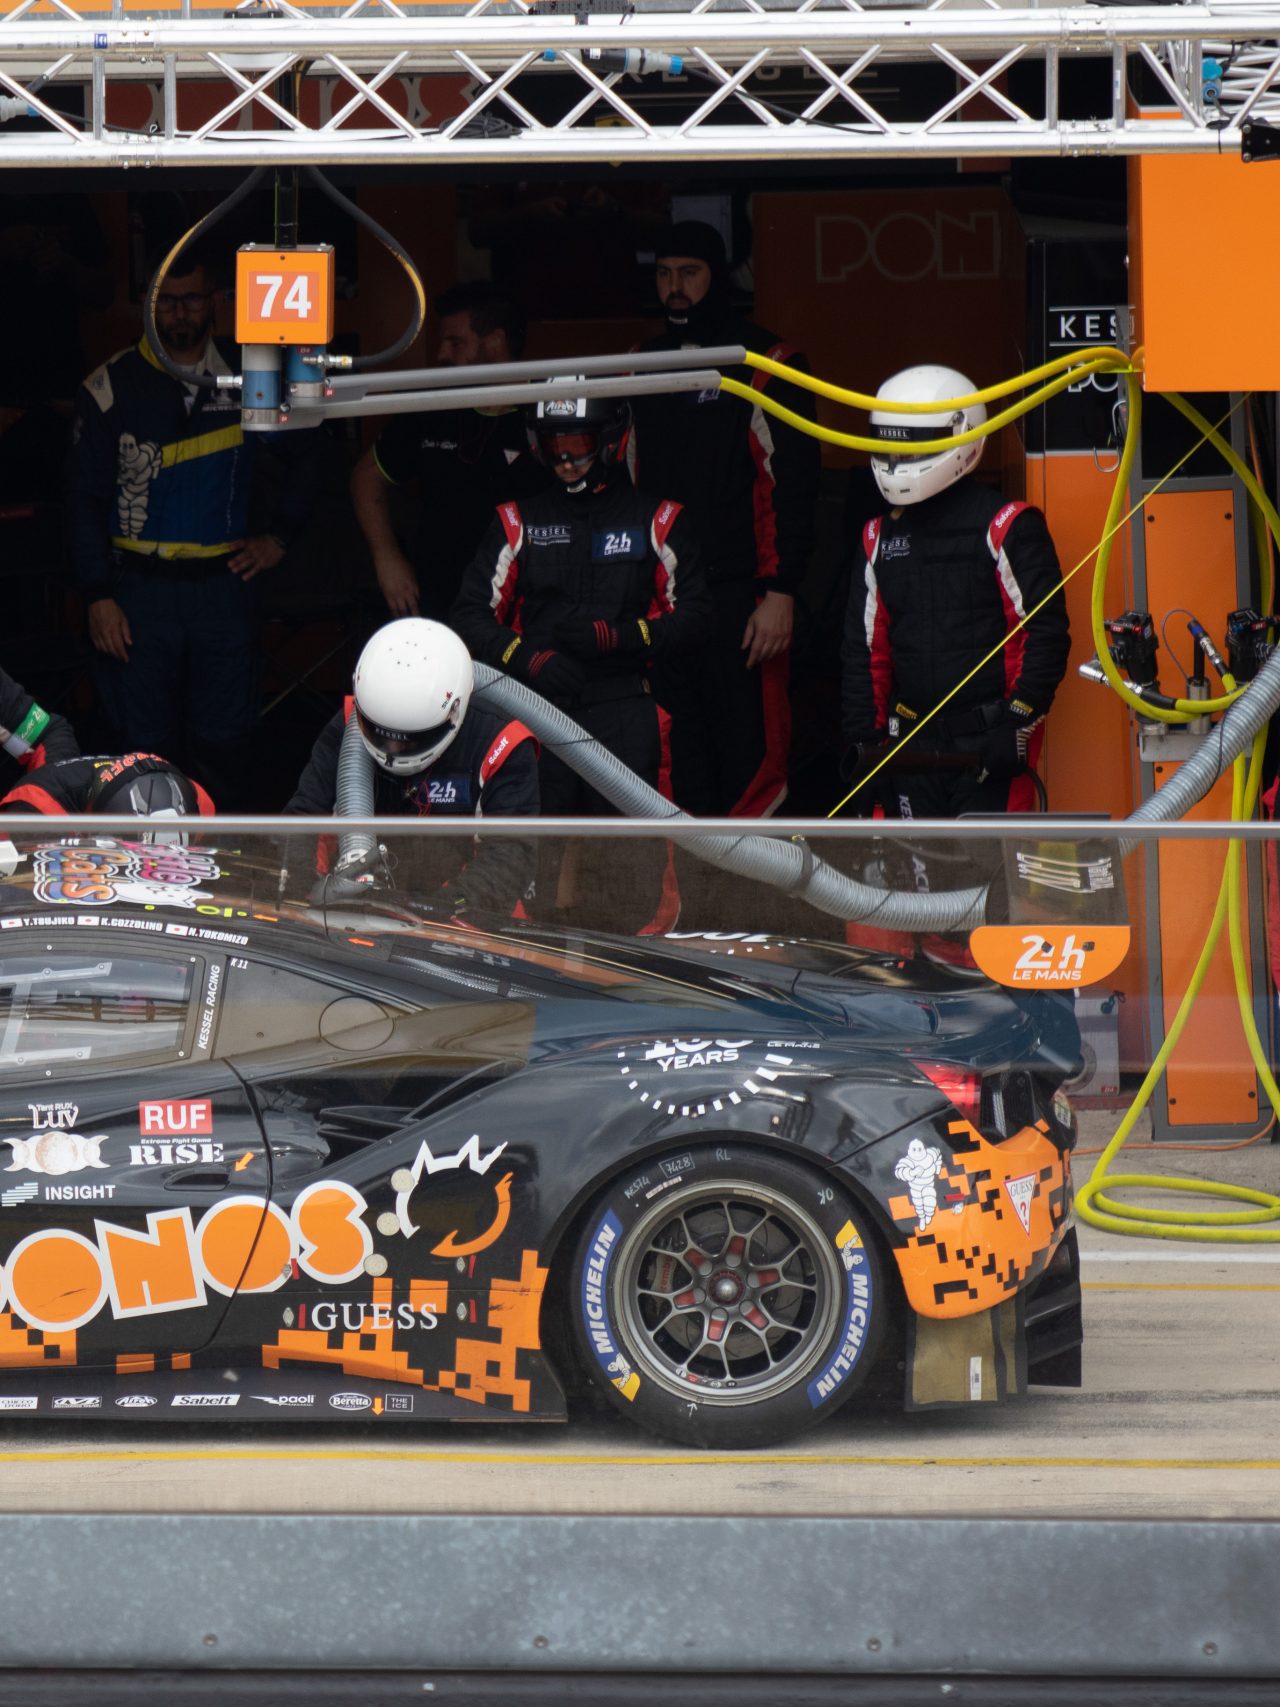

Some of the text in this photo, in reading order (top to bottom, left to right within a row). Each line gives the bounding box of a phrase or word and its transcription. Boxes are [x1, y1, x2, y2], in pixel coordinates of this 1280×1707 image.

[255, 275, 311, 319] 74
[428, 781, 456, 798] 24h
[1015, 934, 1086, 969] 24h
[1013, 971, 1082, 981] LE MANS
[197, 964, 220, 1050] KESSEL RACING
[657, 1049, 739, 1072] YEARS
[144, 1104, 207, 1130] RUF
[172, 1138, 190, 1146] Fight
[191, 1137, 211, 1145] Game
[129, 1143, 224, 1166] RISE
[716, 1148, 731, 1161] RL
[45, 1184, 116, 1200] INSIGHT
[587, 1223, 616, 1354] MICHELIN
[311, 1302, 438, 1331] GUESS
[816, 1272, 868, 1398] MICHELIN
[179, 1396, 231, 1405] Sabelt
[278, 1395, 315, 1406] paoli
[333, 1397, 369, 1406] Beretta
